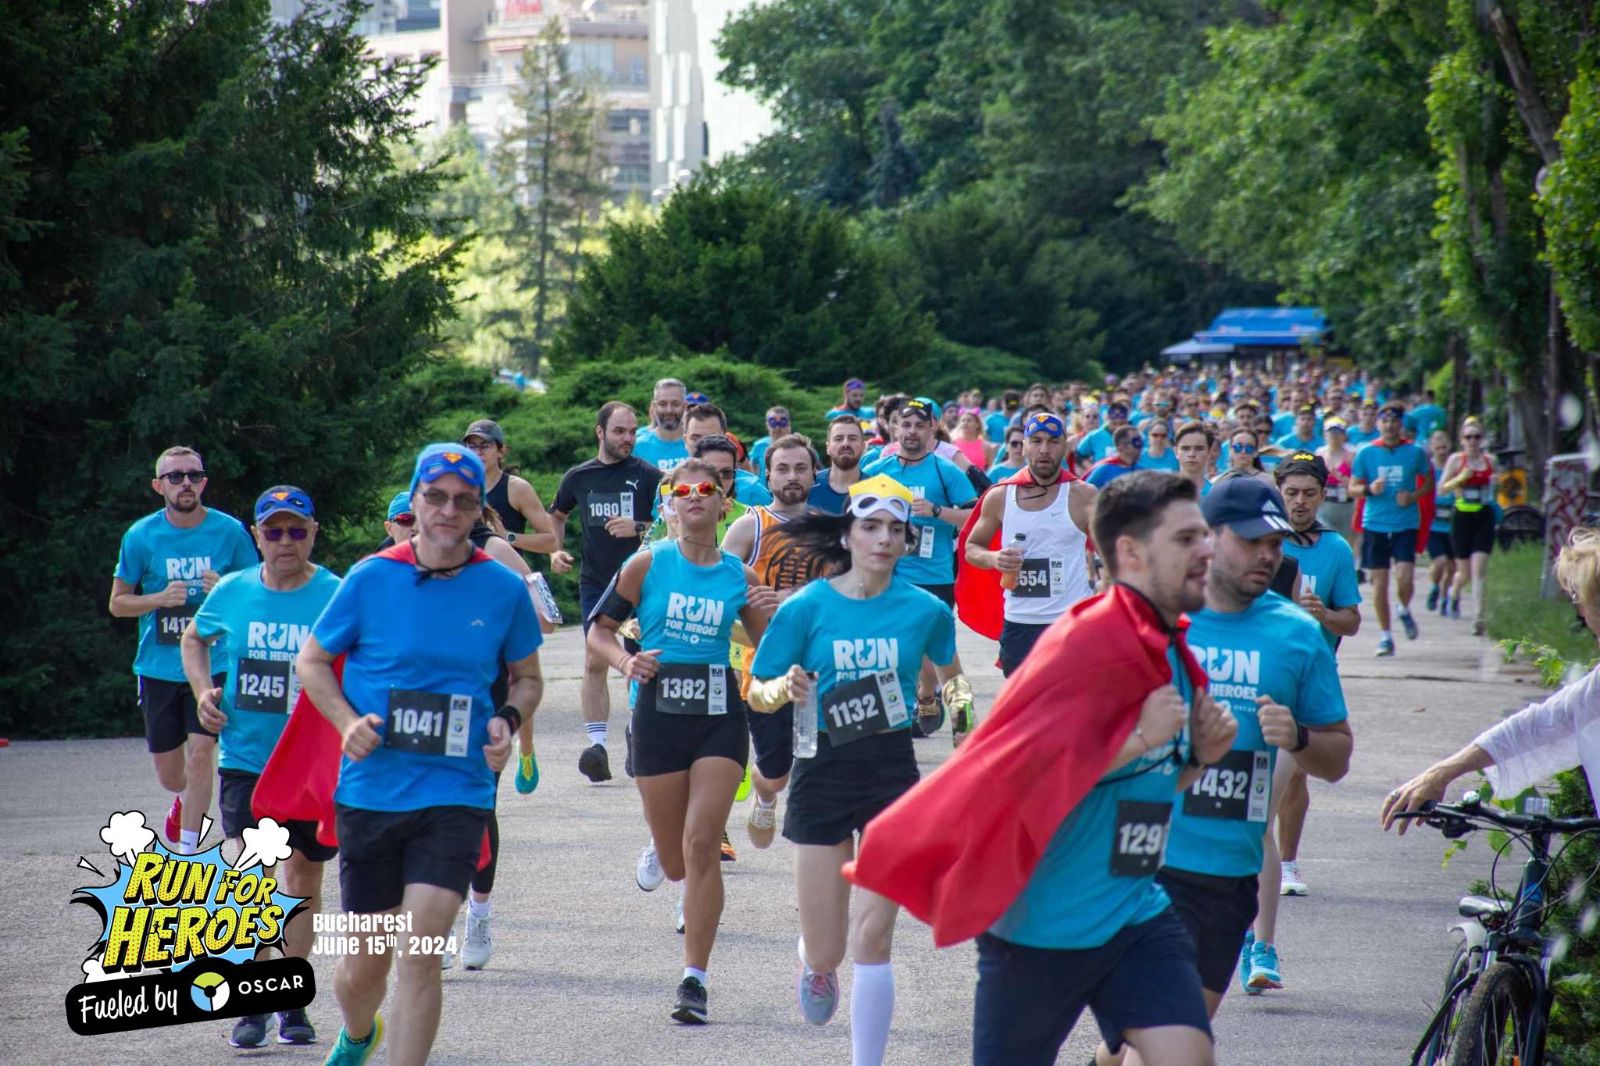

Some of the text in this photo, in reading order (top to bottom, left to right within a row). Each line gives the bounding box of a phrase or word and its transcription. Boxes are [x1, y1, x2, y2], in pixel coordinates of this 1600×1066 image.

[589, 503, 619, 517] 1080
[166, 556, 211, 580] RUN
[1016, 570, 1047, 587] 554
[666, 592, 724, 626] RUN
[247, 621, 310, 651] RUN
[665, 618, 719, 637] FOR HEROES
[248, 649, 268, 660] FOR
[833, 638, 898, 670] RUN
[240, 673, 285, 698] 1245
[661, 678, 706, 699] 1382
[1208, 683, 1258, 701] HEROES
[392, 707, 444, 737] 1041
[829, 693, 879, 728] 1132
